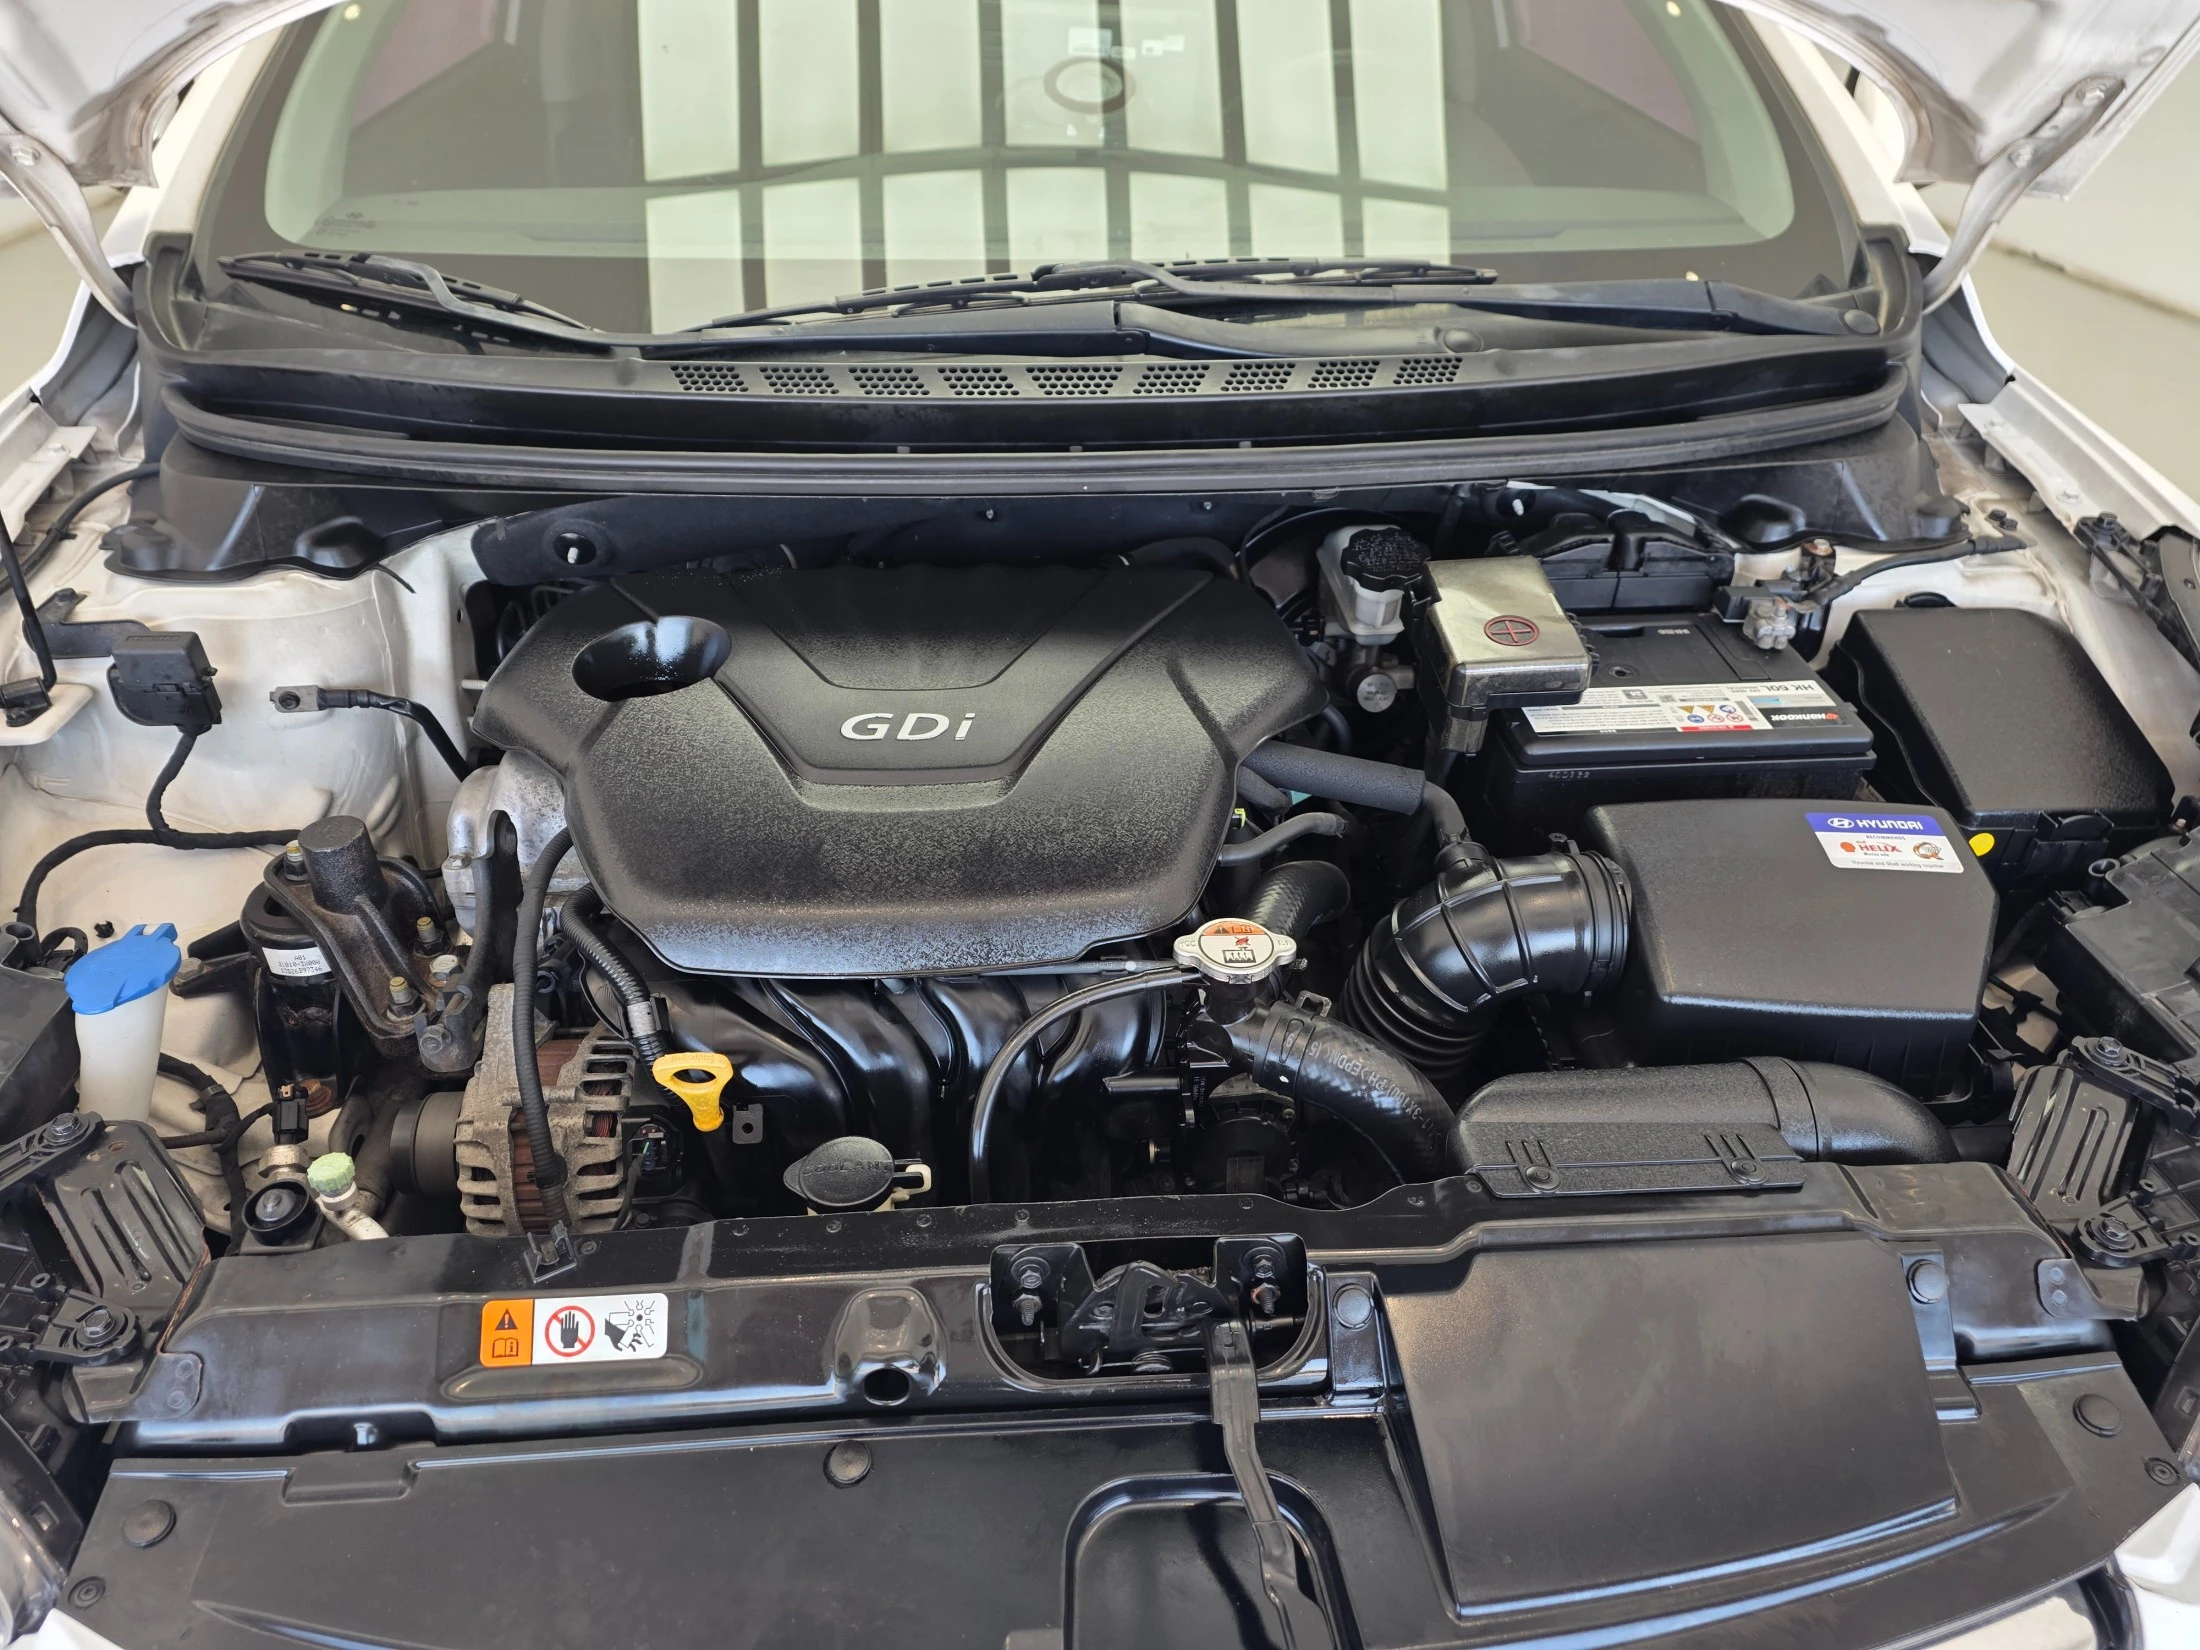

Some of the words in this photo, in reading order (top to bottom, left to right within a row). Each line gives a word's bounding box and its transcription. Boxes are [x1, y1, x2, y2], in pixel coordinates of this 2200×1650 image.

[1763, 684, 1789, 693] 60L
[1792, 684, 1815, 692] HK
[840, 712, 976, 741] GDi
[1856, 819, 1924, 830] HYUNDAI
[1858, 844, 1903, 853] HELIX
